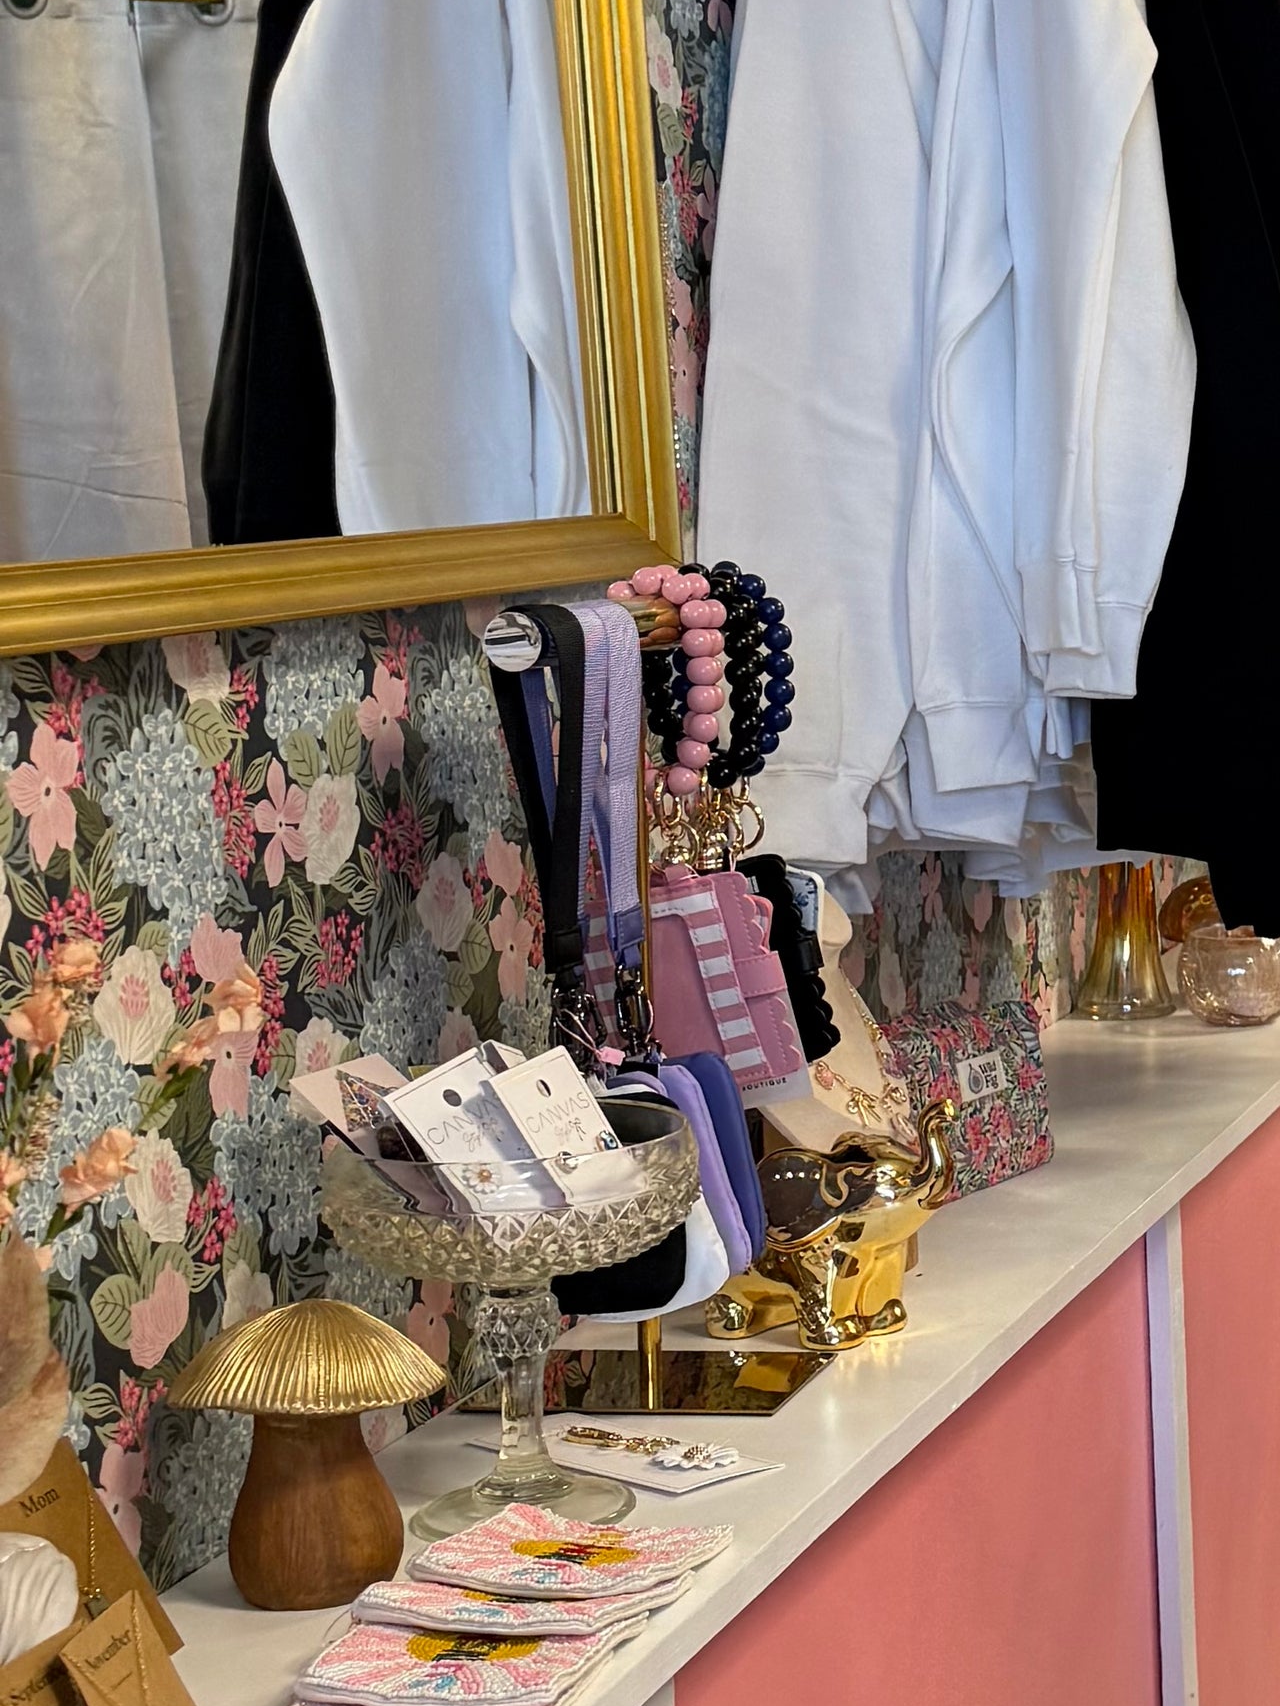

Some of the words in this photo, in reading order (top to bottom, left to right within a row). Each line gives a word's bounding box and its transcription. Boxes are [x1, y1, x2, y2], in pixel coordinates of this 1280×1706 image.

[426, 1097, 503, 1146] CANVA
[526, 1090, 590, 1134] CANVAS
[18, 1487, 61, 1519] Mom
